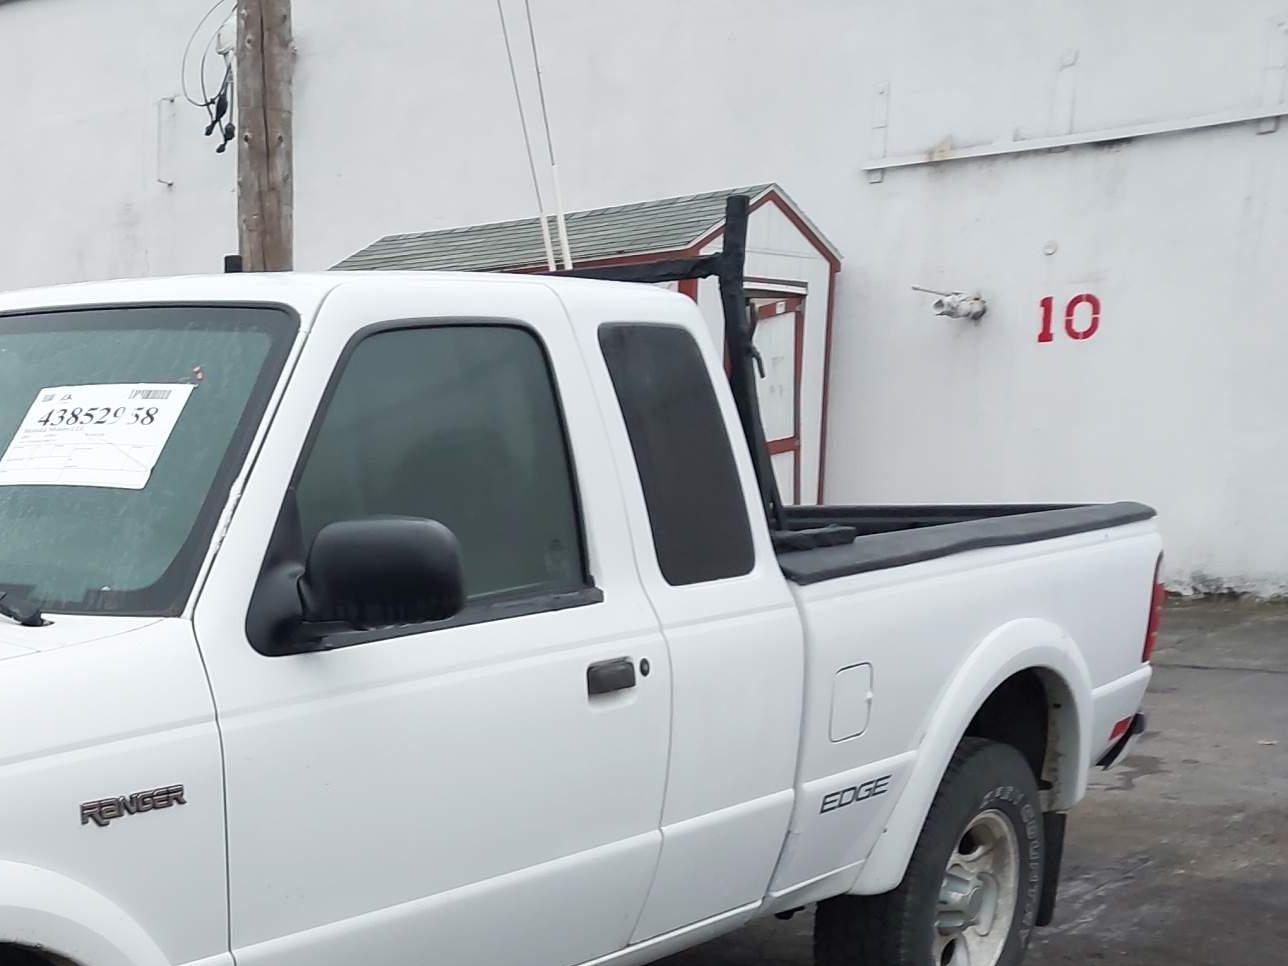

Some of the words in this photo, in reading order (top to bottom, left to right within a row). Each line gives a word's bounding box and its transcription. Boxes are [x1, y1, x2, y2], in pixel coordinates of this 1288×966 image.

[1037, 293, 1100, 343] 10
[37, 405, 160, 427] 43852958
[819, 774, 892, 815] EDGE
